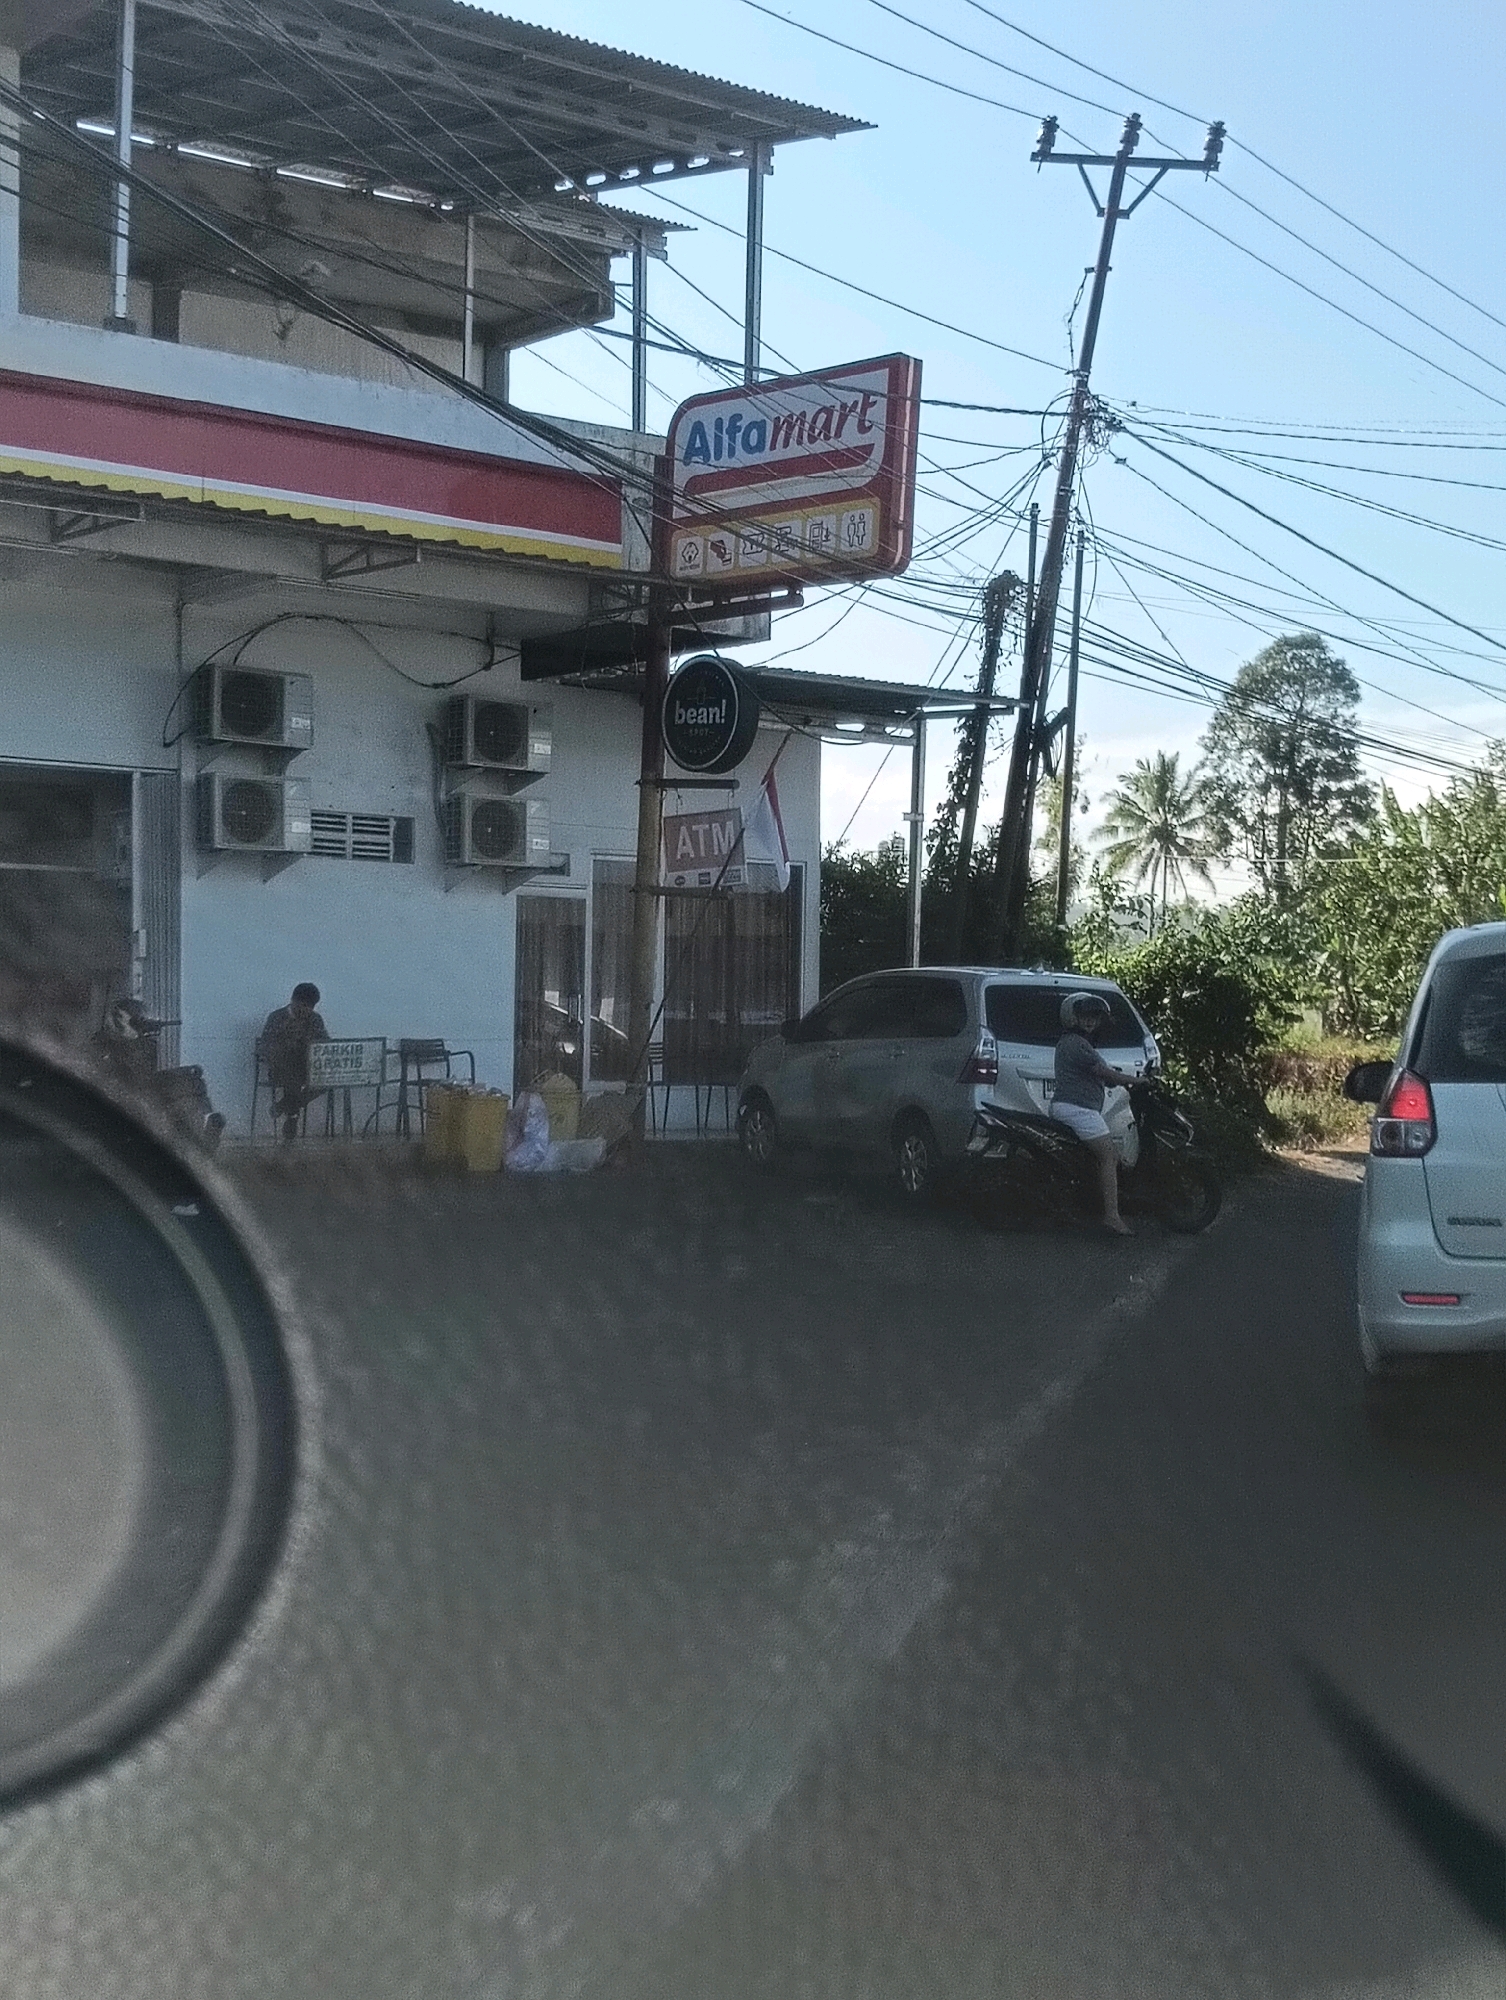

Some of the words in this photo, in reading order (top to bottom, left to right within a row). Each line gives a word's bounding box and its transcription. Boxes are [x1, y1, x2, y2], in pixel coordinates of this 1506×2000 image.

[683, 393, 877, 466] Alfamart
[675, 699, 727, 725] bean!
[677, 820, 736, 860] ATM
